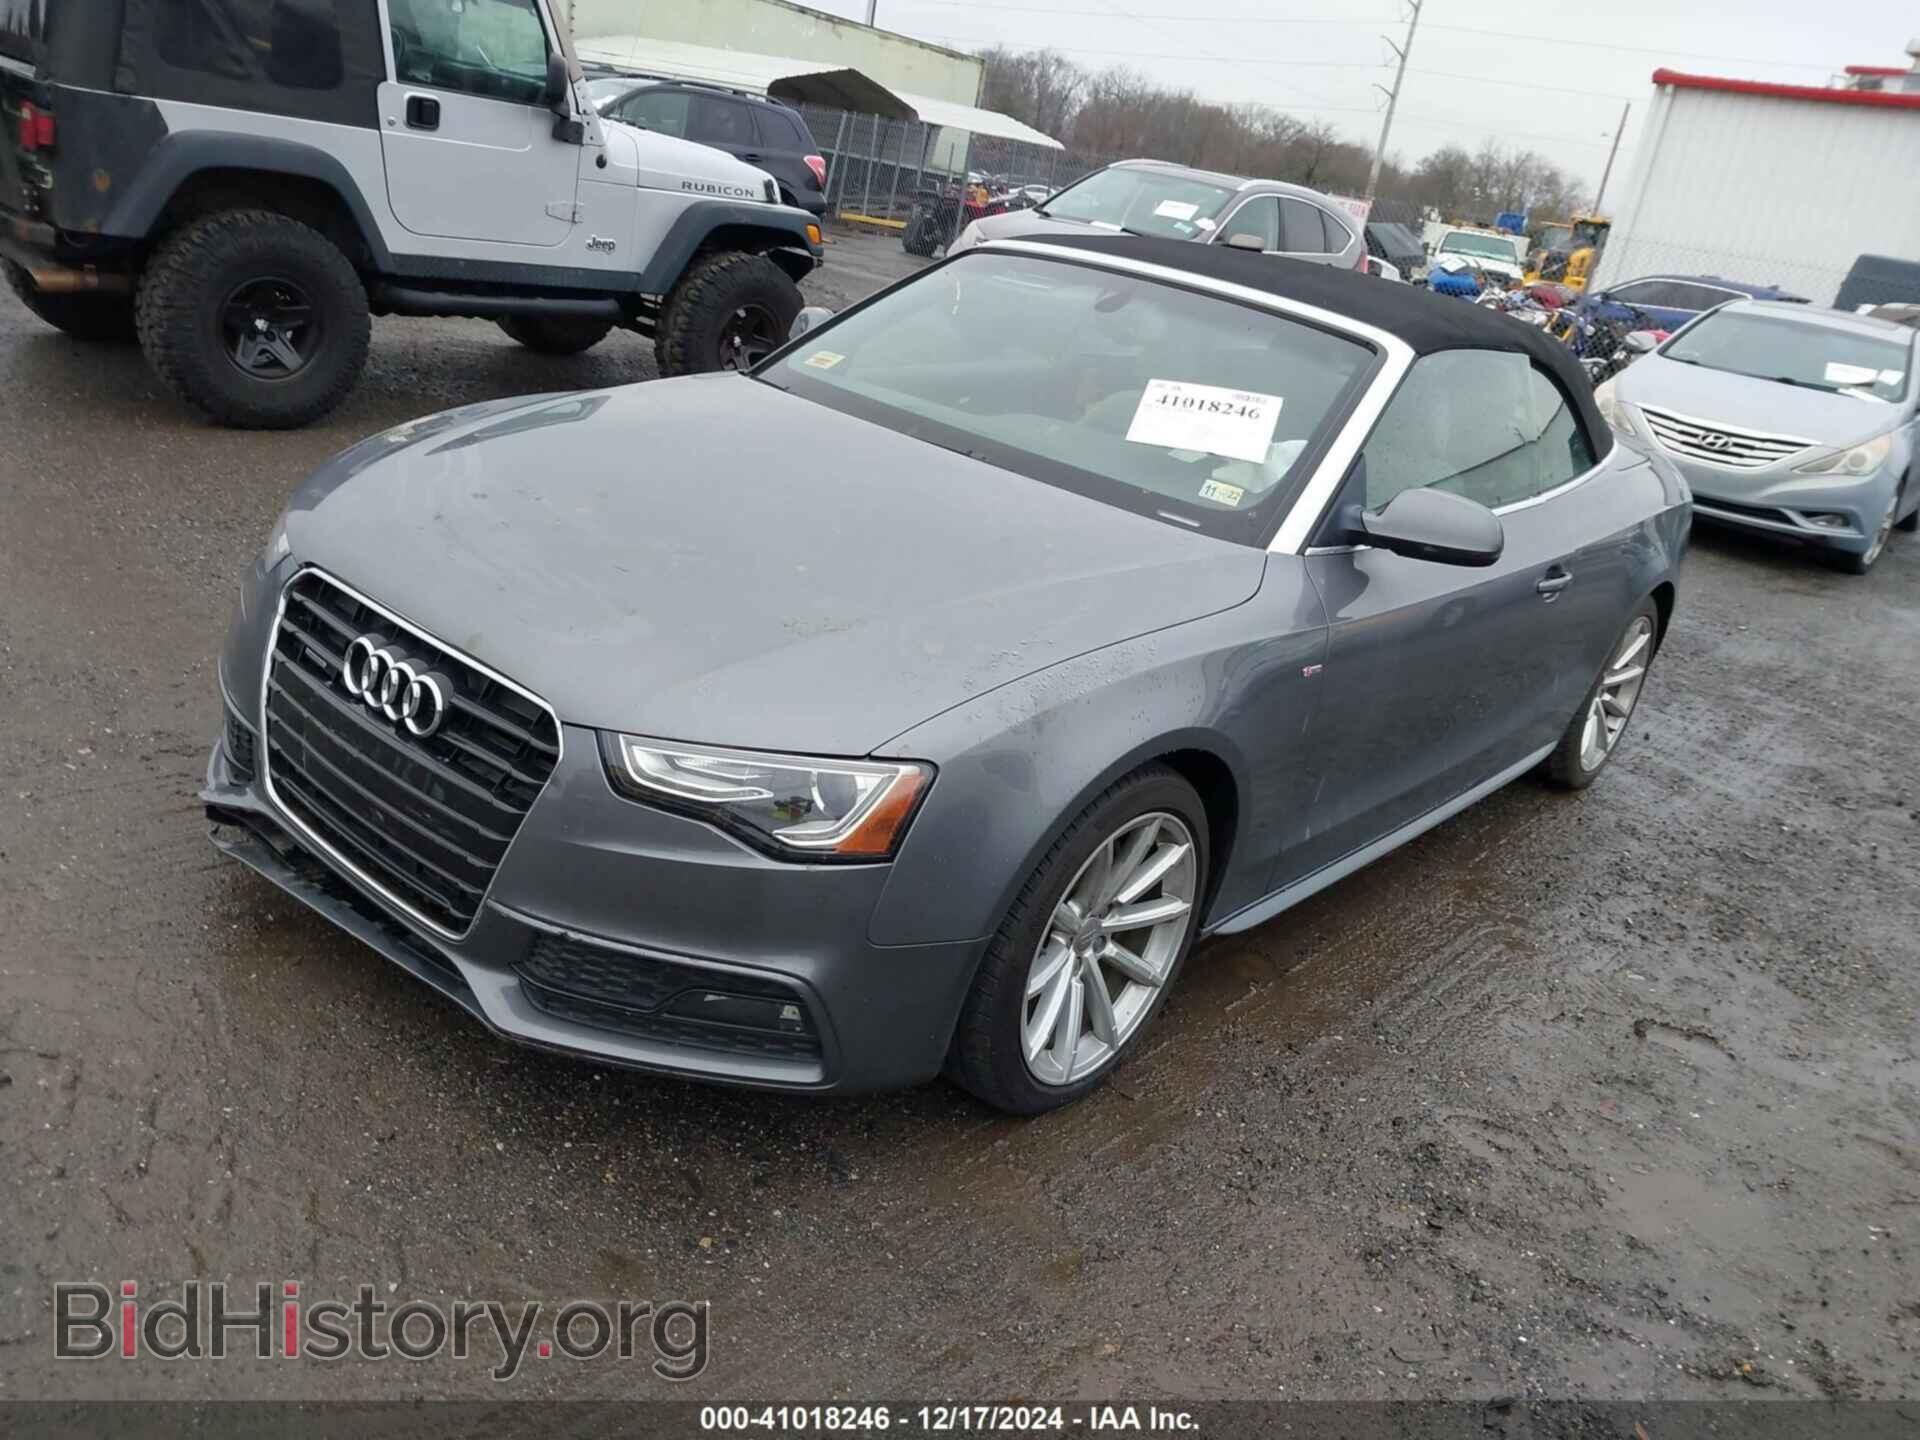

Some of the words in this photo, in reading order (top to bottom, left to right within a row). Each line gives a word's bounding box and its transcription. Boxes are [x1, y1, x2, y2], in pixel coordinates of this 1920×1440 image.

[681, 180, 755, 198] RUBICON
[585, 236, 617, 255] Jeep
[1155, 393, 1261, 420] 41018246
